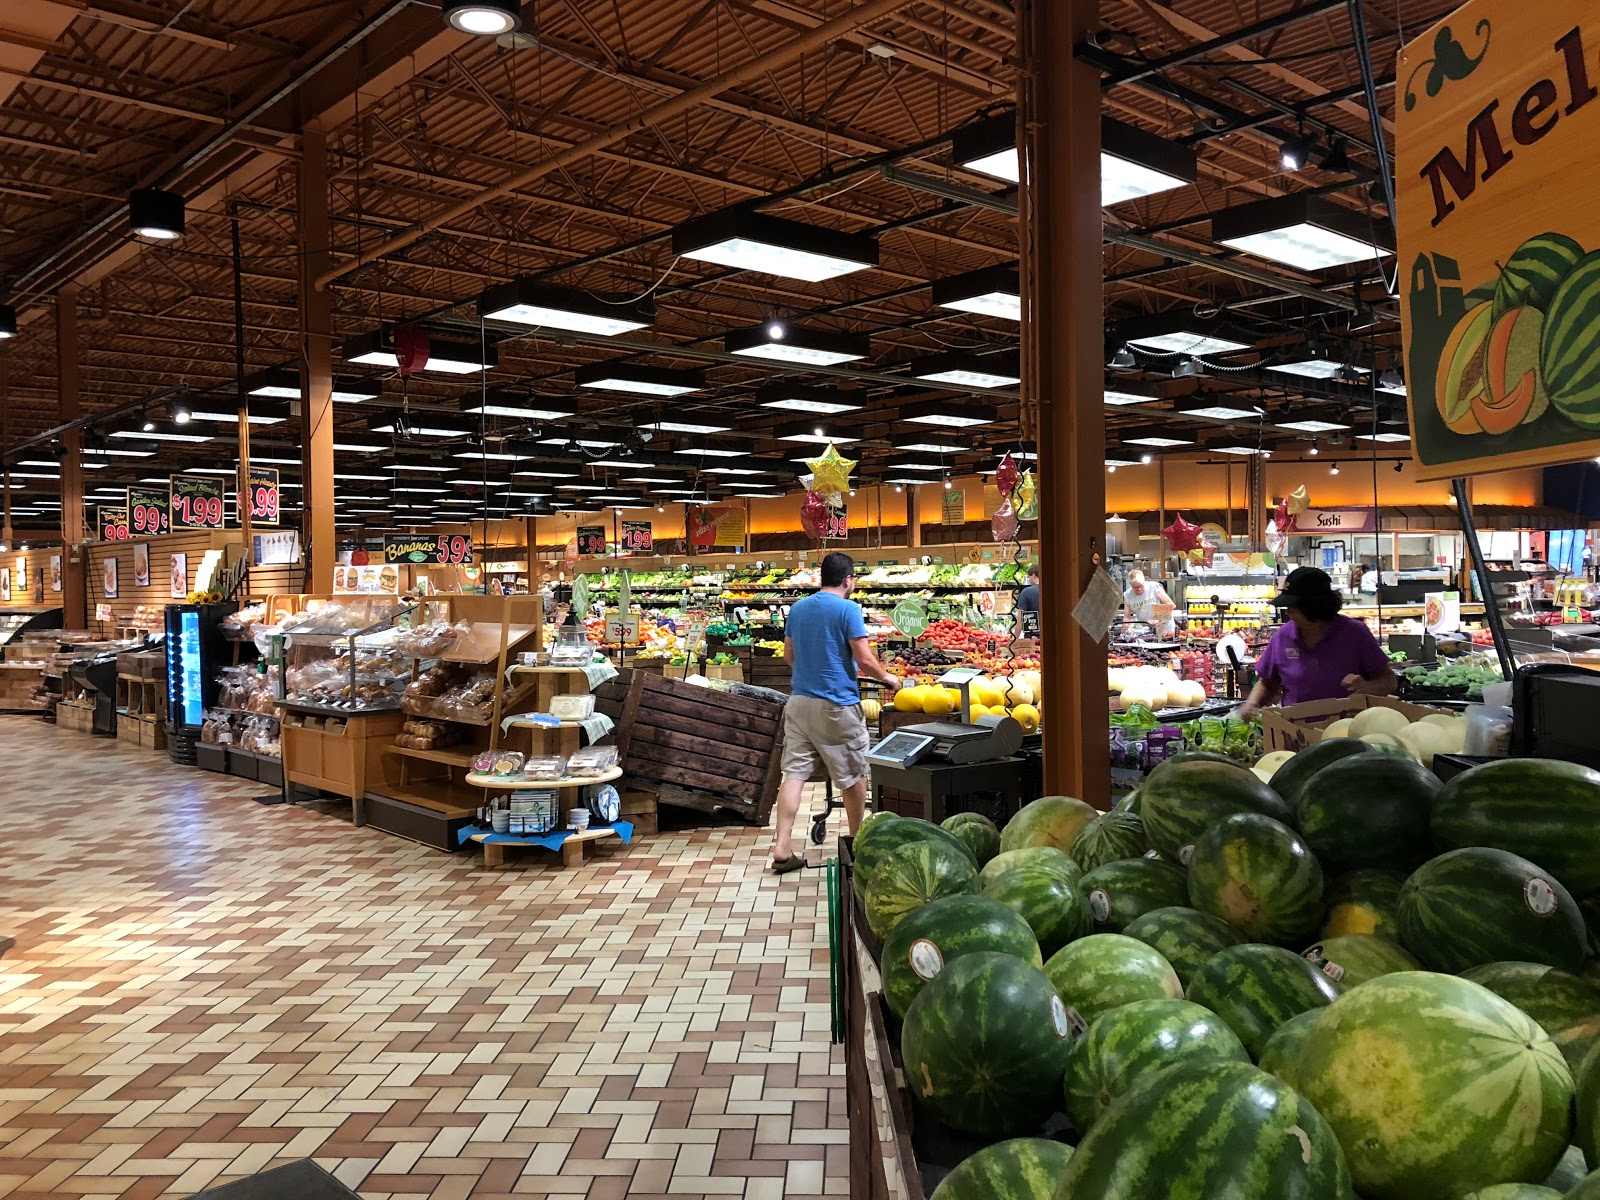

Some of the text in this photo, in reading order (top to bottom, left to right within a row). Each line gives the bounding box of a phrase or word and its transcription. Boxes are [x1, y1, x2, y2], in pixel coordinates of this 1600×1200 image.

[1419, 25, 1599, 228] Mel
[173, 494, 222, 524] $1.99
[1316, 513, 1341, 527] Sushi
[385, 542, 436, 561] Bananas
[894, 610, 925, 633] Organic
